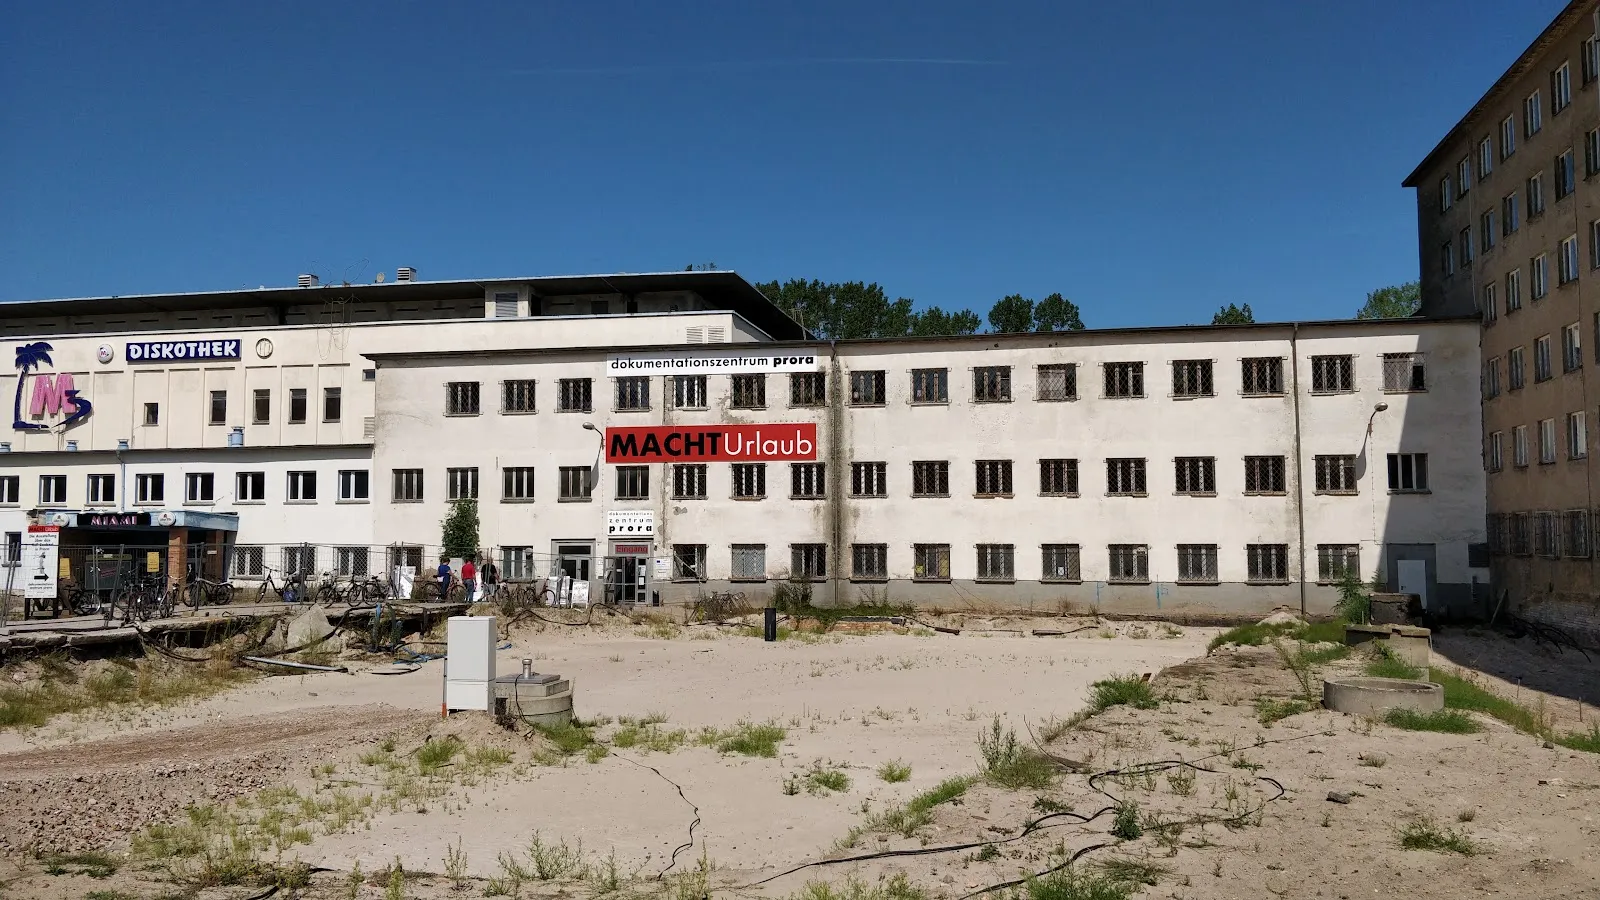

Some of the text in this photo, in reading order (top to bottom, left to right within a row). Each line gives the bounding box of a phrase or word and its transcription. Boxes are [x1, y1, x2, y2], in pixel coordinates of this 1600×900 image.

[129, 341, 237, 360] DISKOTHEK
[611, 356, 814, 369] dokumentationszentrum prora
[90, 515, 138, 526] MIAMI
[609, 525, 652, 534] prora
[616, 545, 648, 554] Eingang
